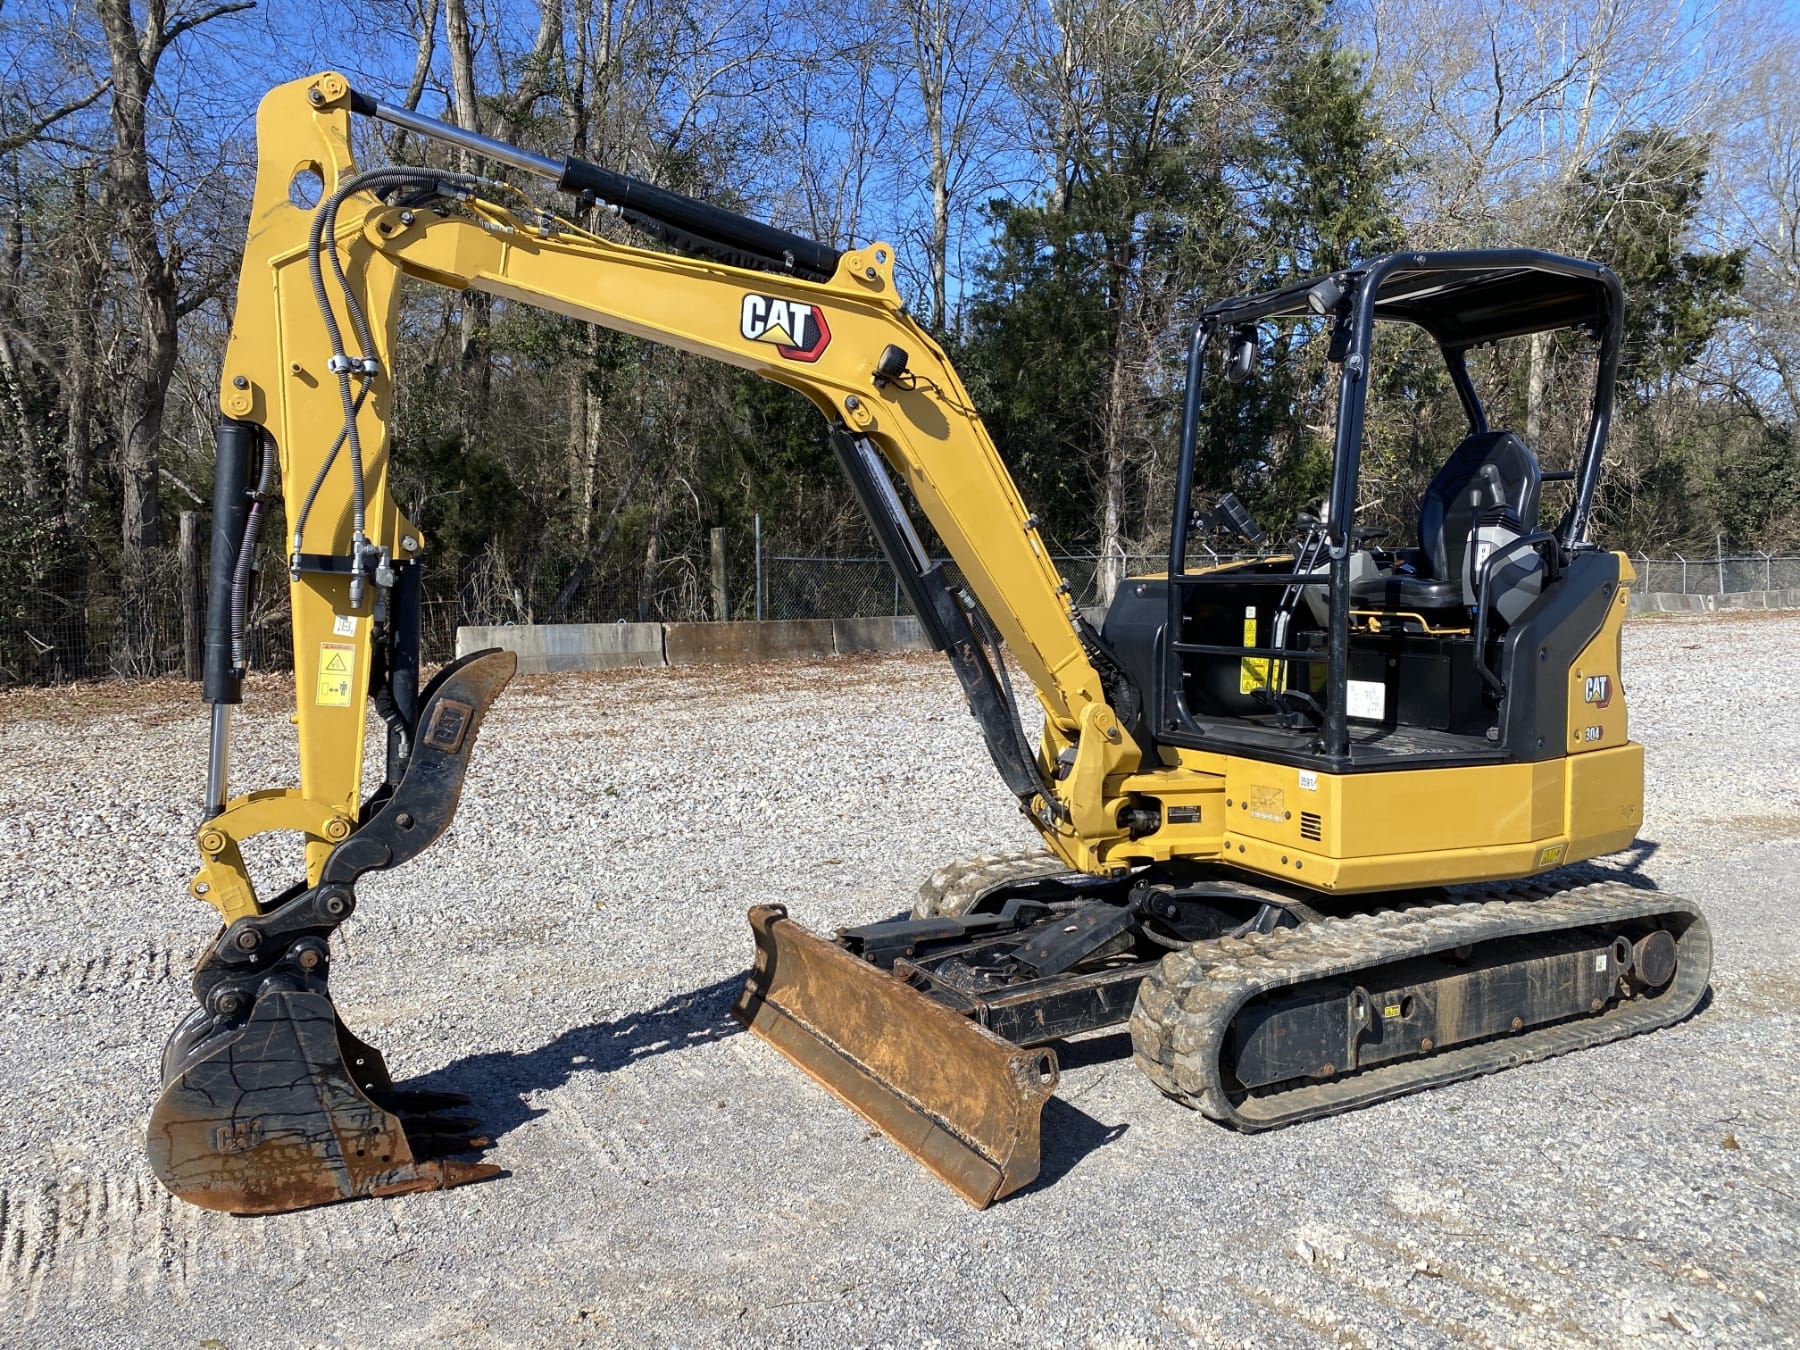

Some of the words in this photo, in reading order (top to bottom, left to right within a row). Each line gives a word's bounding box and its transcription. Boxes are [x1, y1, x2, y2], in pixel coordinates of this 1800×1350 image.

[742, 294, 812, 348] CAT
[1585, 676, 1607, 702] CAT
[216, 1120, 262, 1153] CAT
